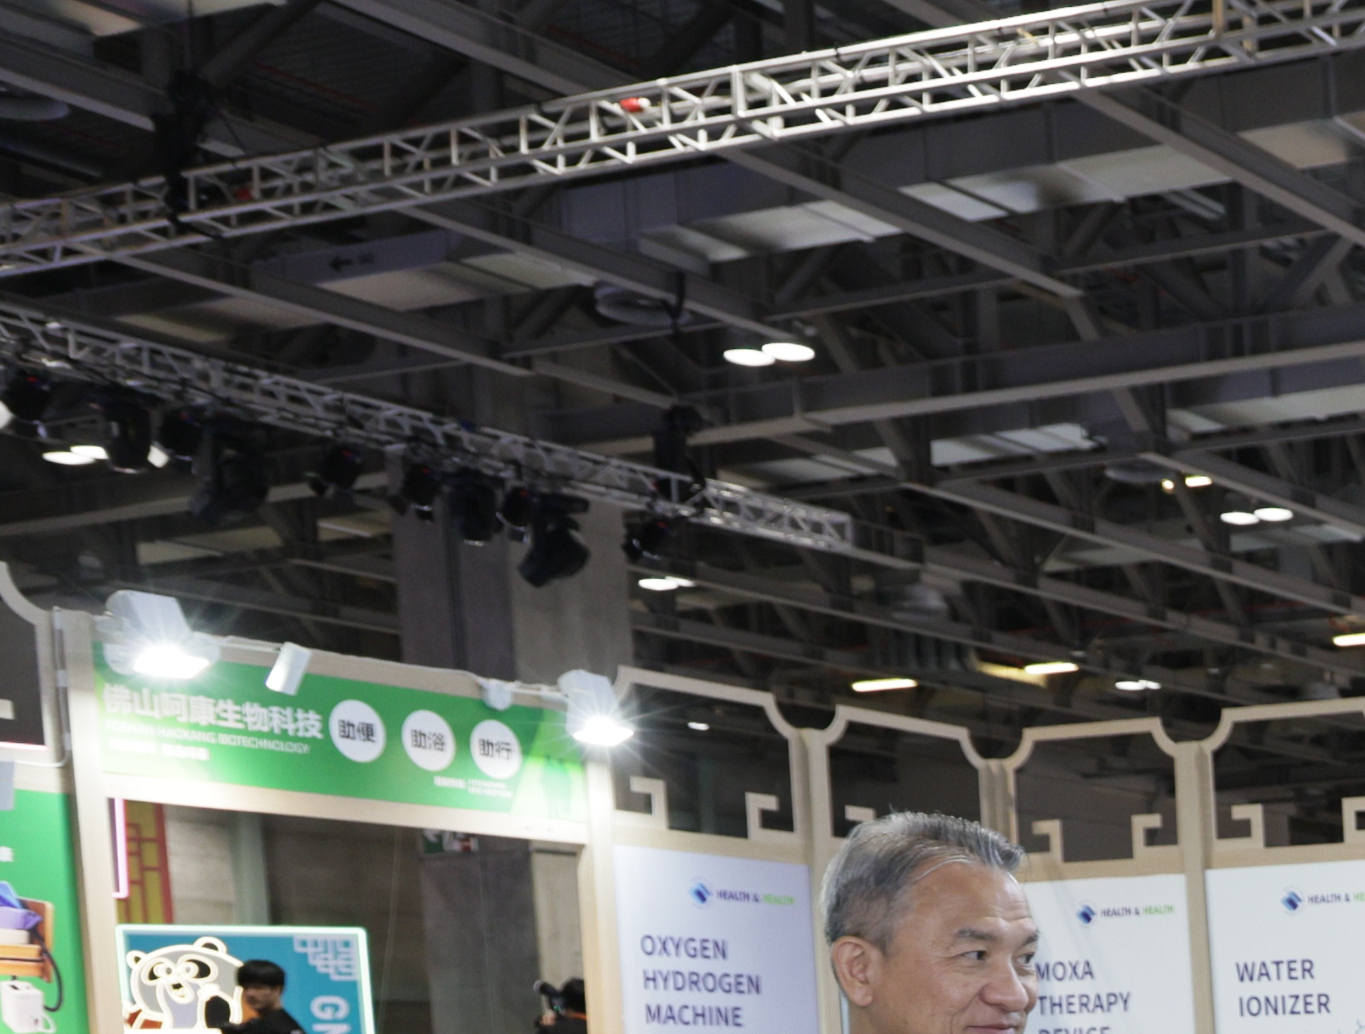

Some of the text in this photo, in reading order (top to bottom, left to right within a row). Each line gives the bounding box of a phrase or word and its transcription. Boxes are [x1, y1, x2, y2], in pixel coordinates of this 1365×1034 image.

[338, 719, 377, 743] 助便
[410, 729, 447, 752] 助浴
[478, 738, 513, 760] 助行
[716, 890, 750, 903] HEALTH
[1308, 893, 1341, 904] HEALTH
[1101, 906, 1132, 918] HEALTH
[1143, 904, 1174, 915] HEALTH
[640, 935, 728, 961] OXYGEN
[643, 969, 762, 995] HYDROGEN
[1036, 959, 1095, 983] MOXA
[1235, 958, 1316, 983] WATER
[645, 1003, 745, 1028] MACHINE
[1037, 991, 1132, 1016] THERAPY
[1238, 993, 1331, 1017] IONIZER
